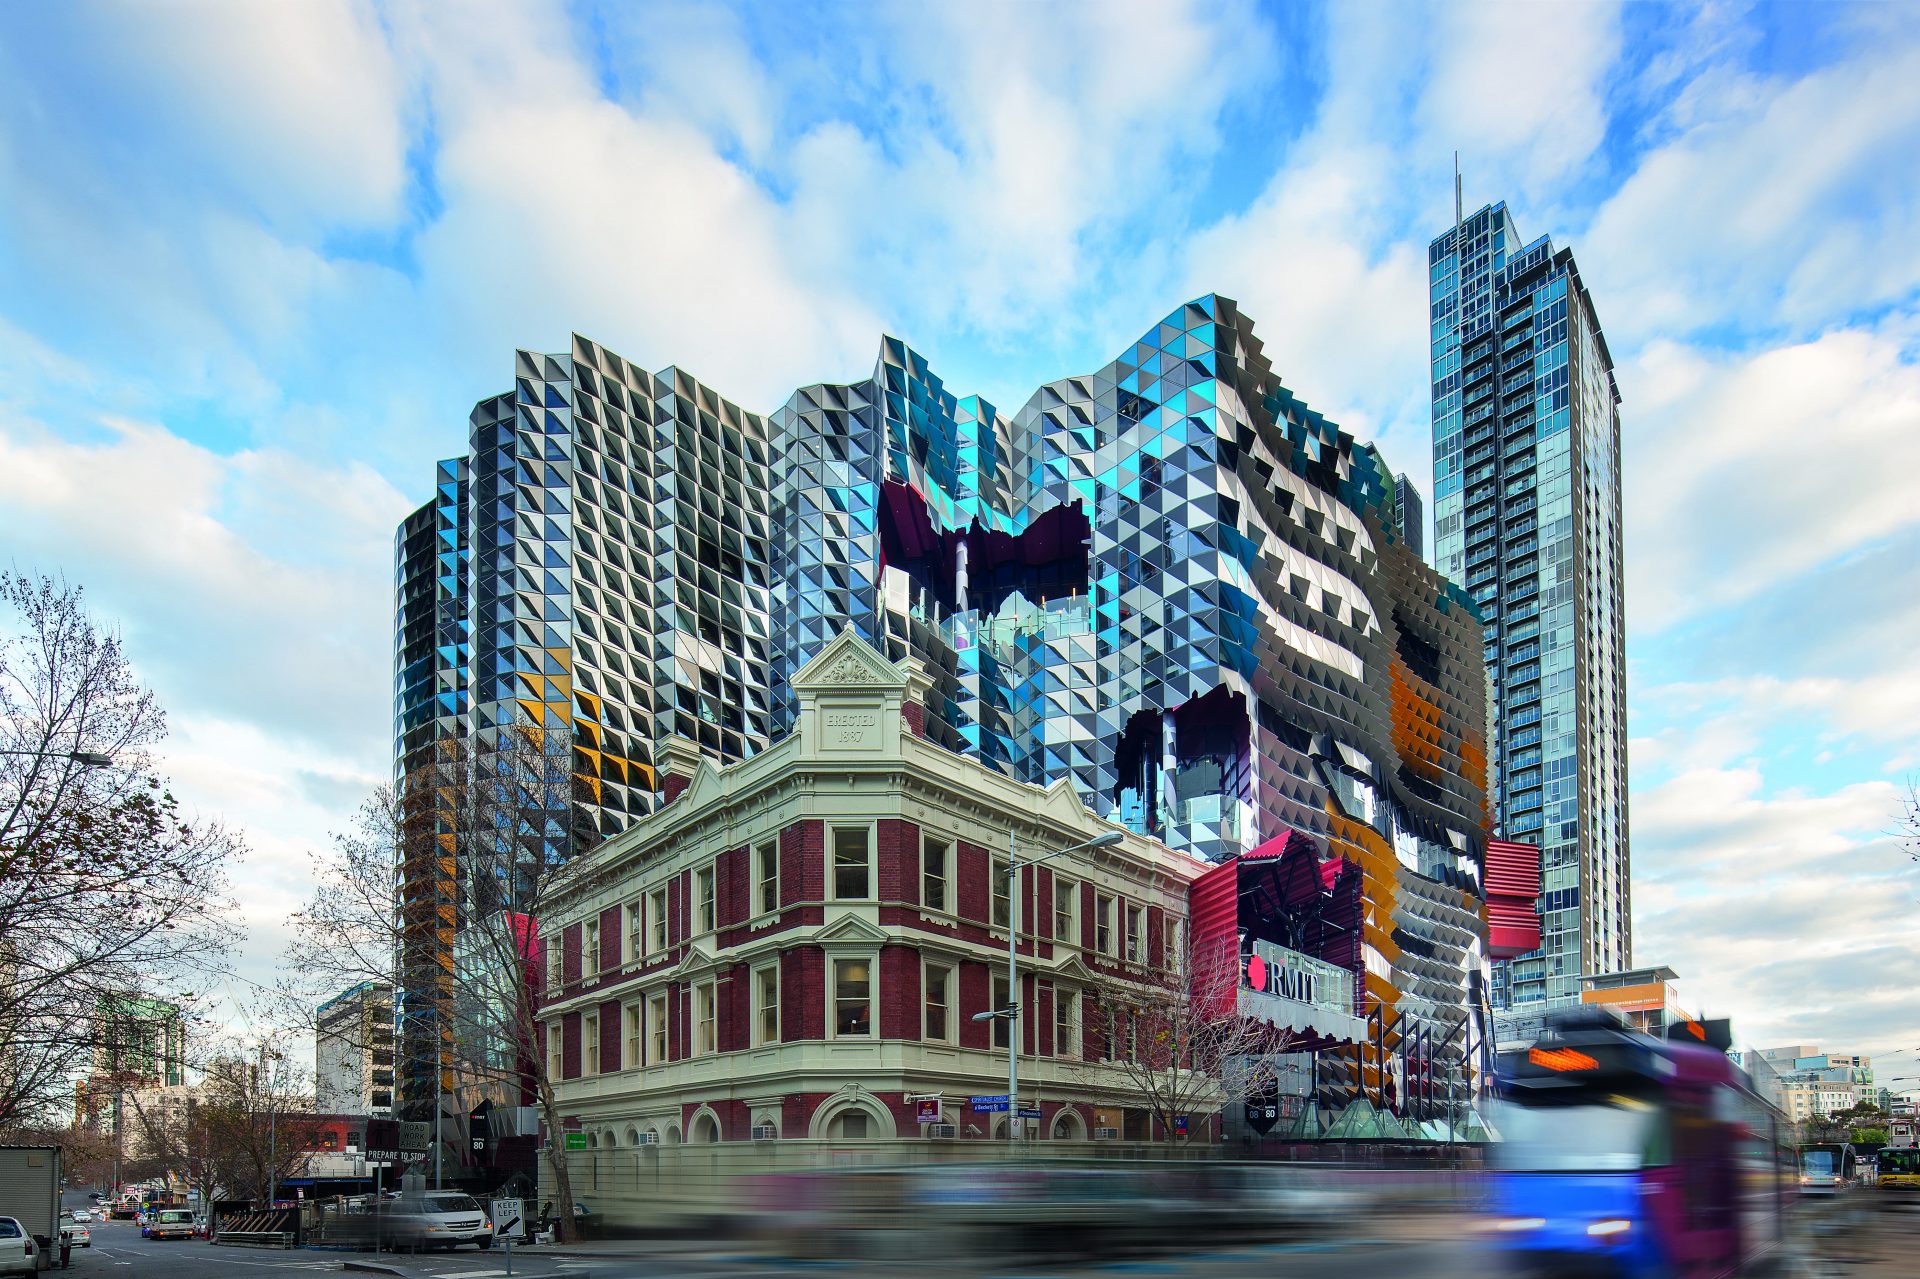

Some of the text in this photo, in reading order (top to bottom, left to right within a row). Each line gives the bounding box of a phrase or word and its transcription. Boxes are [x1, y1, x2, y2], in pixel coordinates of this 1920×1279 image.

[827, 715, 876, 727] ERECTED
[839, 731, 864, 743] 1887
[1268, 960, 1318, 1005] RMIT
[1265, 1109, 1276, 1118] 80
[404, 1123, 425, 1132] ROAD
[404, 1132, 425, 1140] WORK
[400, 1140, 428, 1149] AHEAD
[473, 1141, 484, 1149] 80
[368, 1150, 426, 1161] PREPARE TO STOP
[497, 1201, 518, 1209] KEEP
[498, 1209, 518, 1217] LEFT
